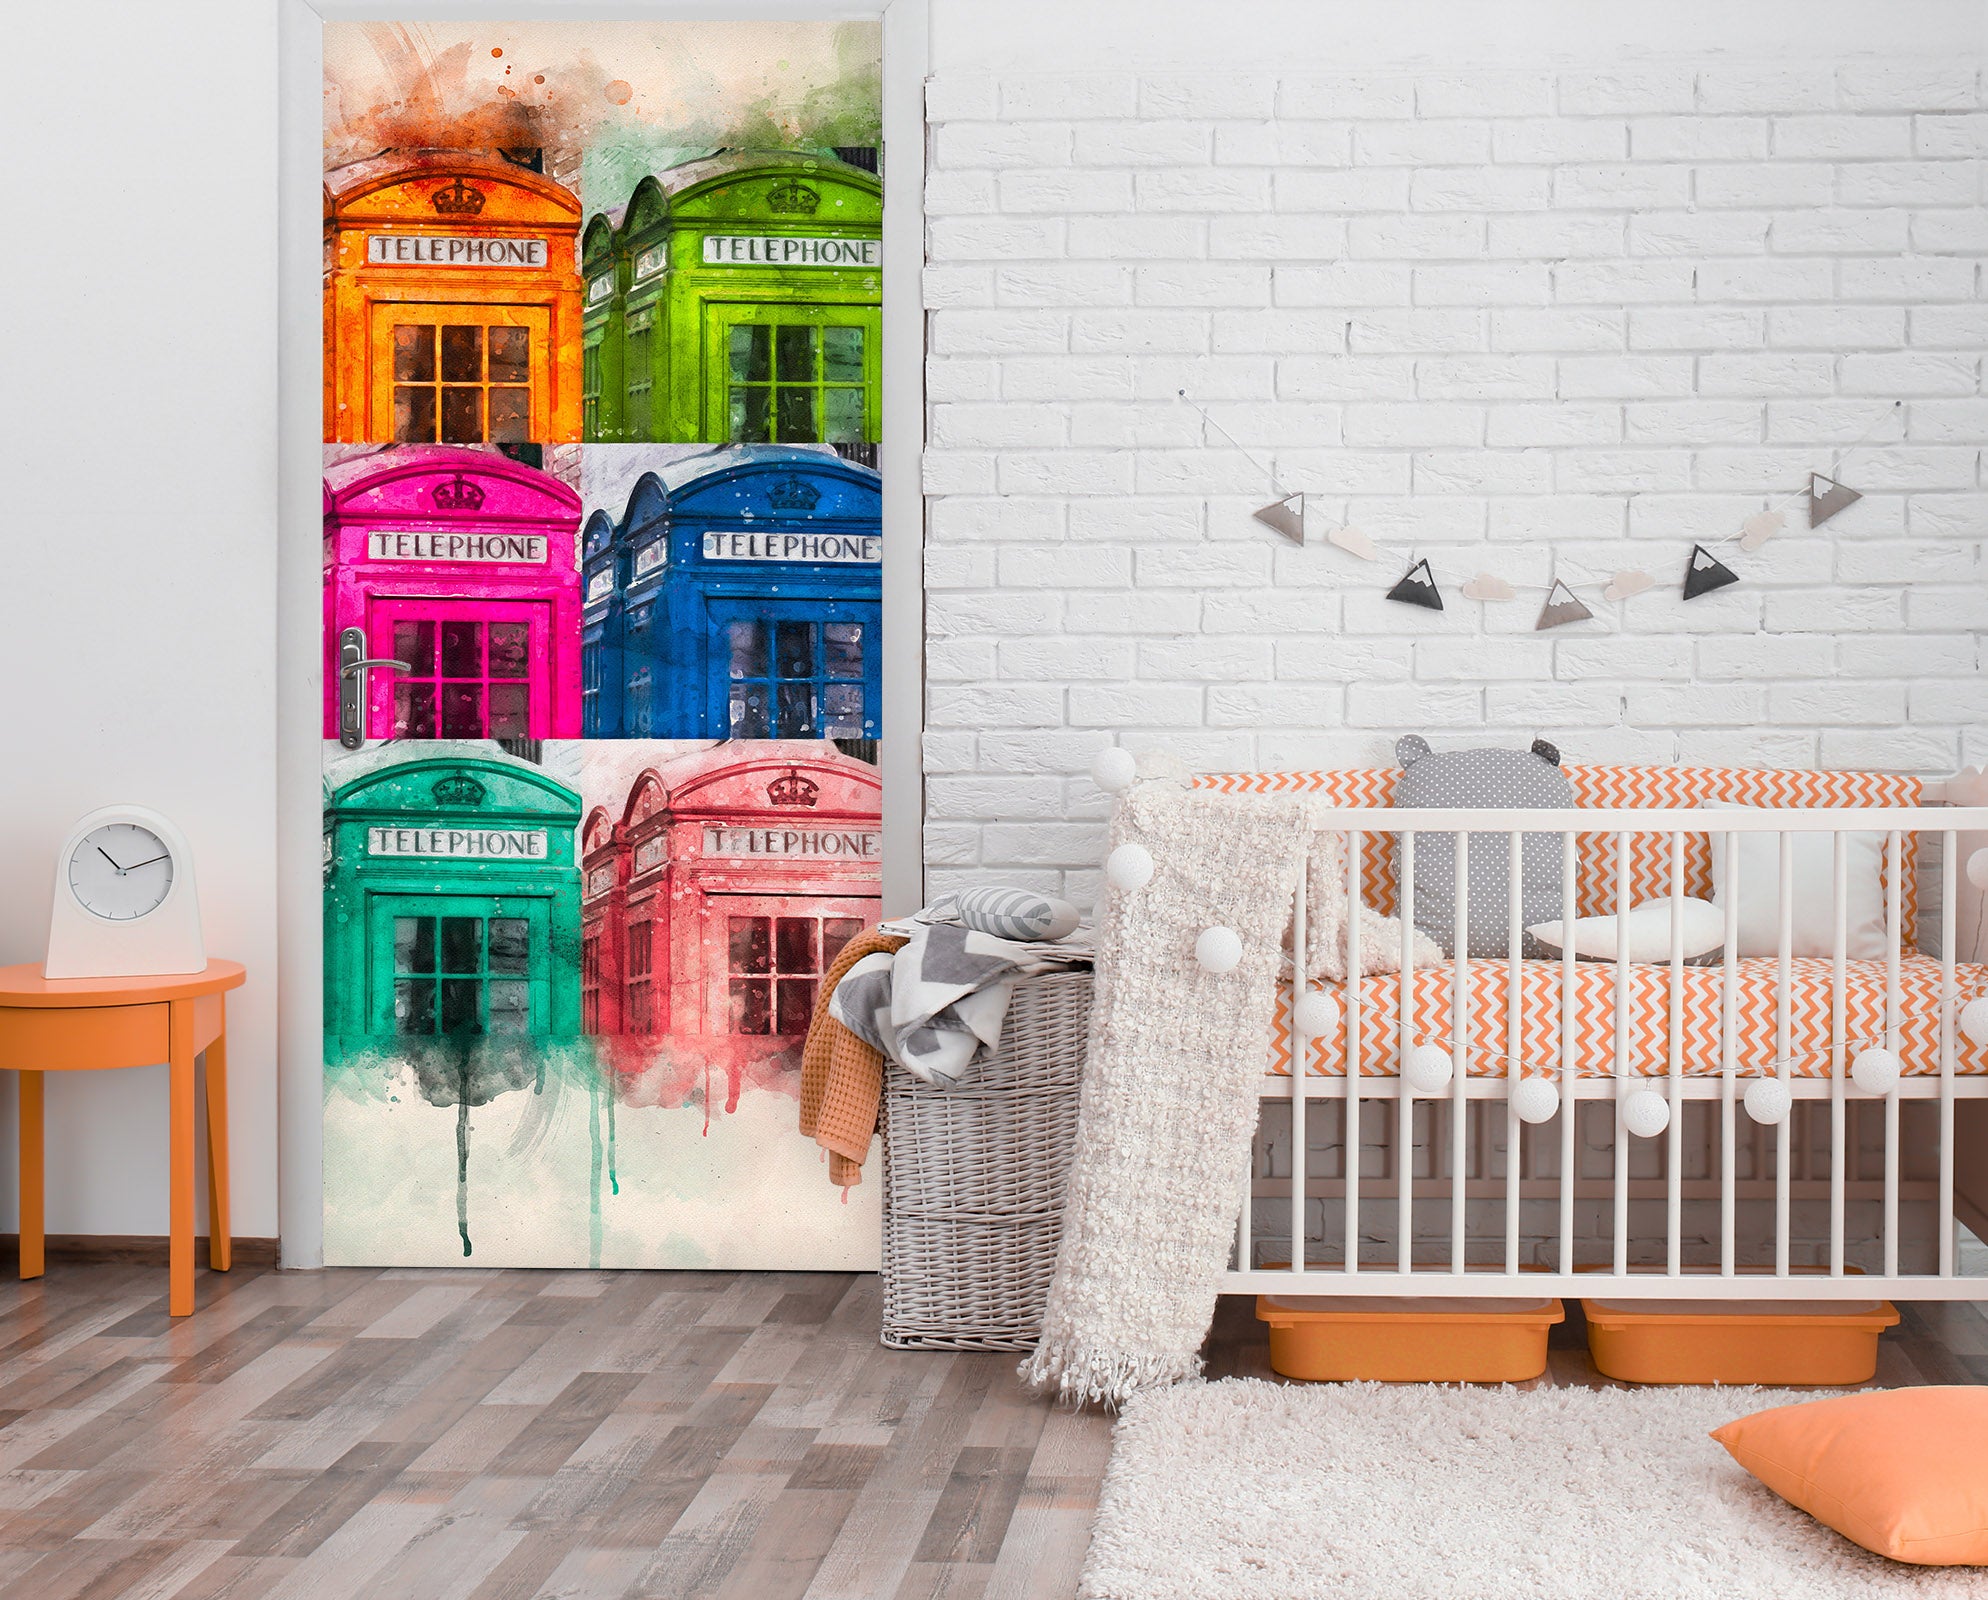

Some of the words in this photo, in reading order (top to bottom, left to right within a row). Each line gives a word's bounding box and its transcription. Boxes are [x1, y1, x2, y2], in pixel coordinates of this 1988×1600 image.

[376, 239, 541, 264] TELEPHONE
[711, 239, 876, 264] TELEPHONE
[376, 535, 541, 560] TELEPHONE
[711, 535, 876, 560] TELEPHONE
[376, 831, 541, 856] TELEPHONE
